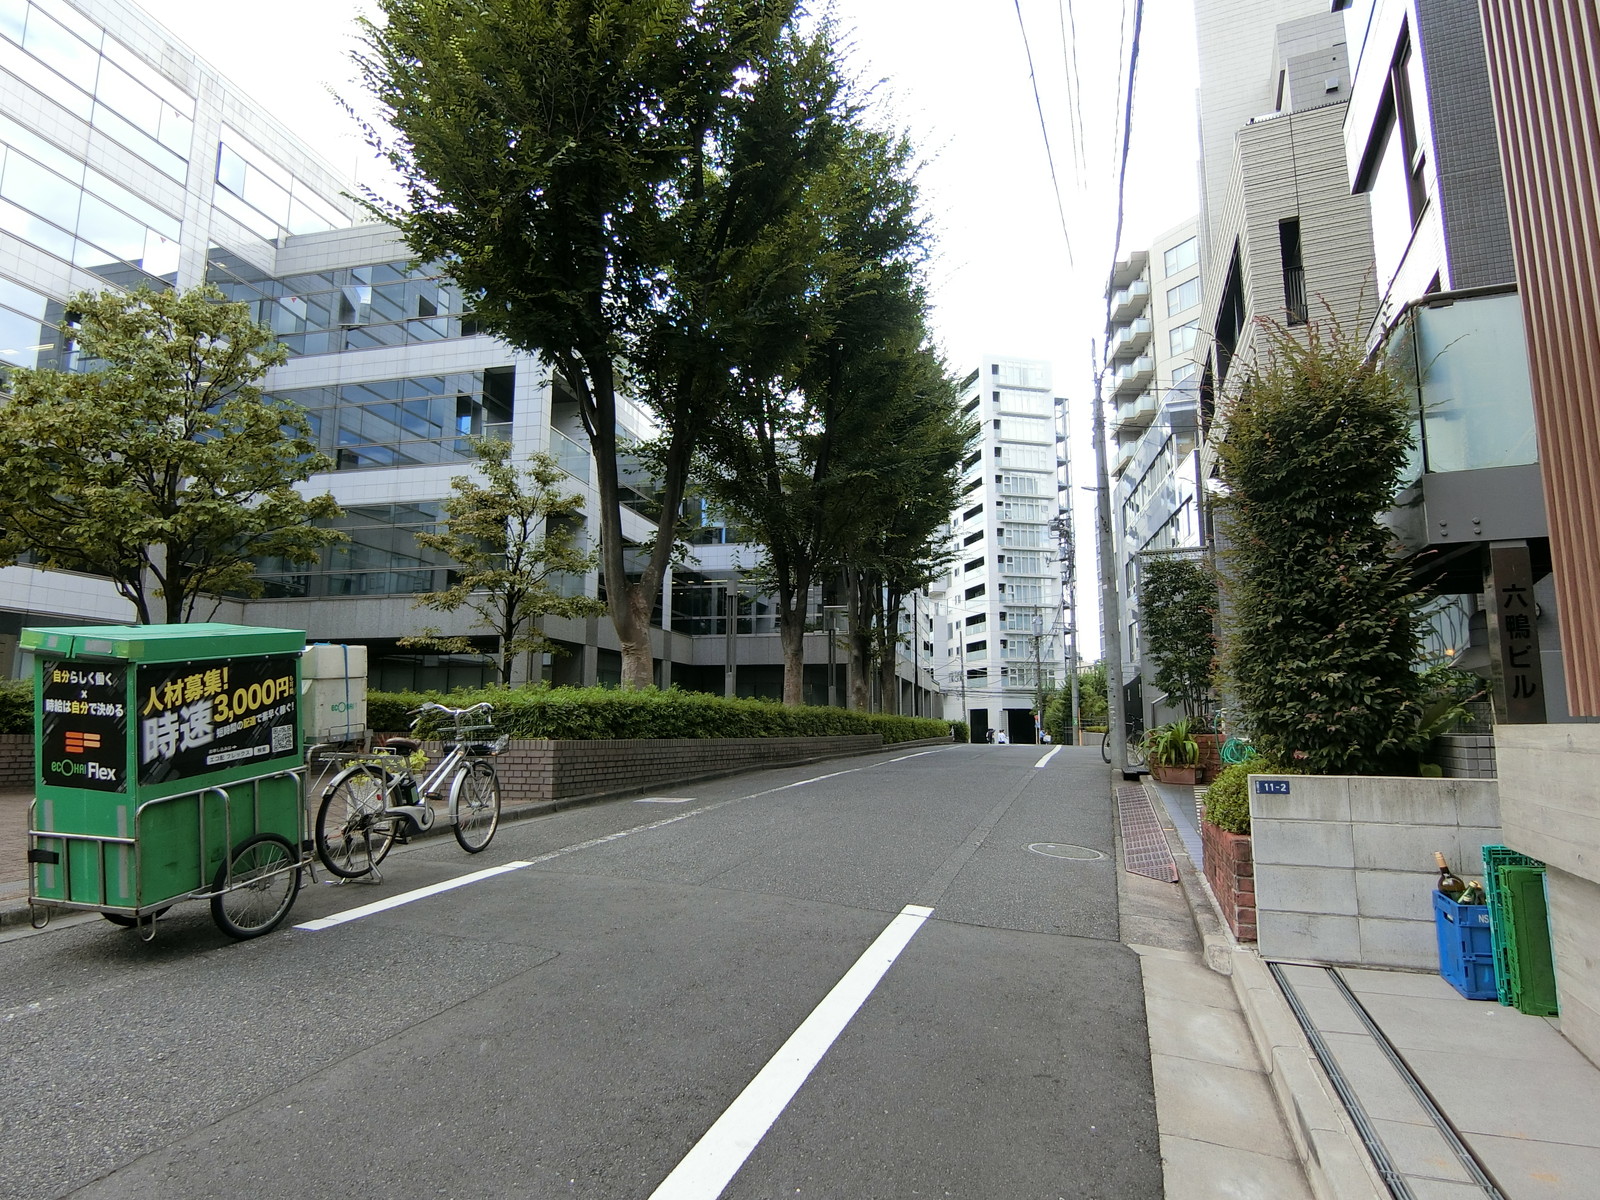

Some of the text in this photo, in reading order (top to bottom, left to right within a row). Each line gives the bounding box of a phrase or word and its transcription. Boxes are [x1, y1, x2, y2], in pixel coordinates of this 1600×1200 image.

[1502, 583, 1536, 699] 六鴨ビル
[53, 669, 112, 686] 自分らしく働く
[45, 698, 124, 717] 時給は自分で決める
[87, 762, 117, 781] Flex
[1264, 783, 1287, 792] 11-2
